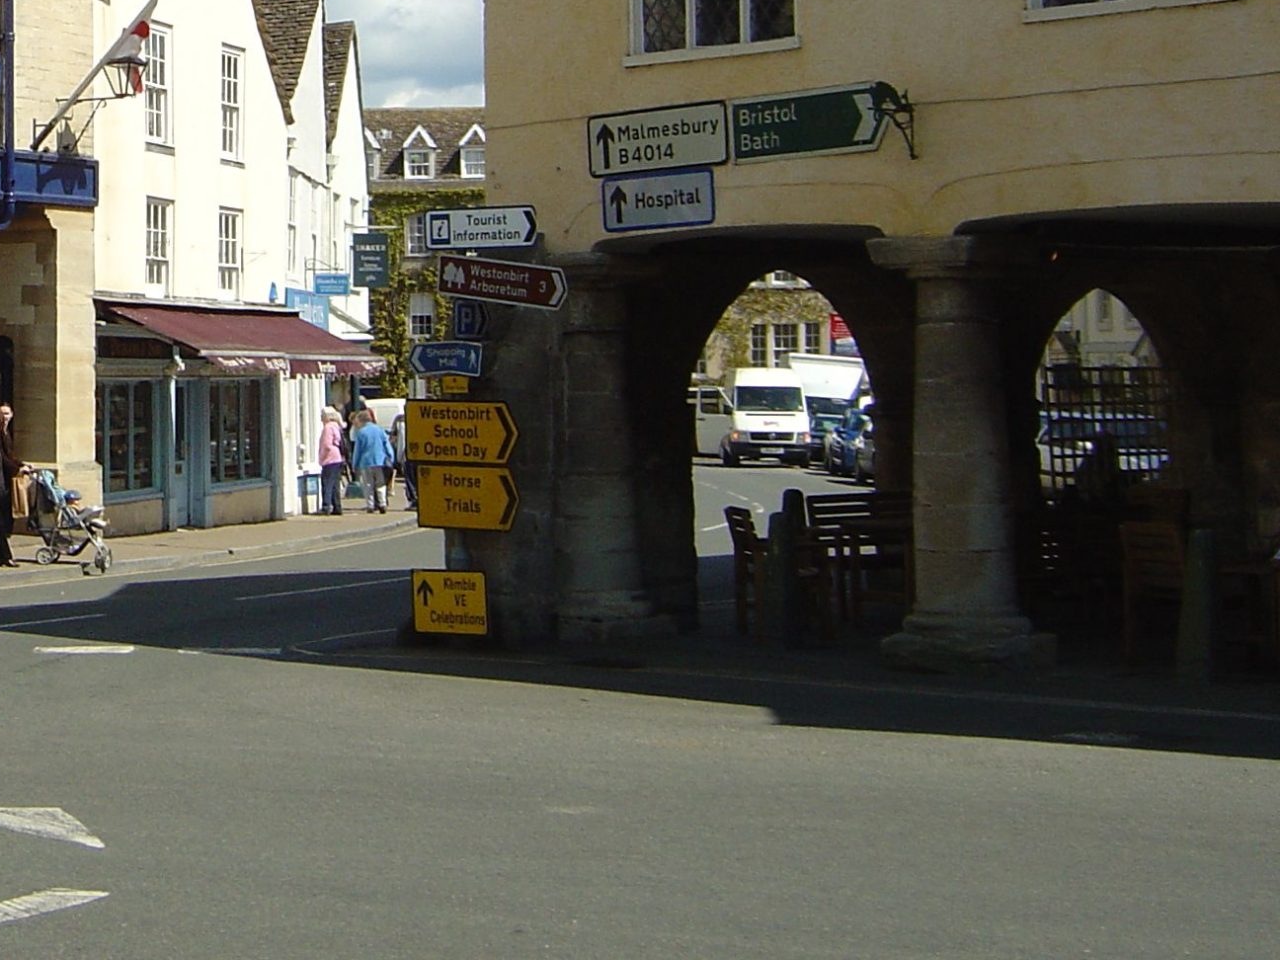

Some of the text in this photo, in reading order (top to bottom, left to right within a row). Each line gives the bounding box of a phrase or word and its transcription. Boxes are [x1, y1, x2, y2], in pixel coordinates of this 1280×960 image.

[738, 103, 798, 127] Bristol
[617, 119, 719, 143] Malmesbury
[739, 131, 781, 151] Bath
[618, 143, 675, 164] B4014
[634, 187, 702, 210] Hospital
[466, 213, 508, 227] Tourist
[452, 228, 522, 242] information
[469, 264, 530, 284] Westonbirt
[469, 279, 528, 298] Arboretum
[539, 280, 547, 294] 3
[461, 307, 473, 332] P
[426, 347, 466, 359] Shopping
[419, 405, 491, 421] Westonbirt
[433, 424, 479, 439] School
[423, 441, 488, 460] Open Day
[442, 472, 482, 488] Horse
[444, 498, 482, 514] Trials
[443, 577, 477, 592] Kemble
[454, 593, 467, 608] VE
[430, 609, 485, 626] Celebrations
